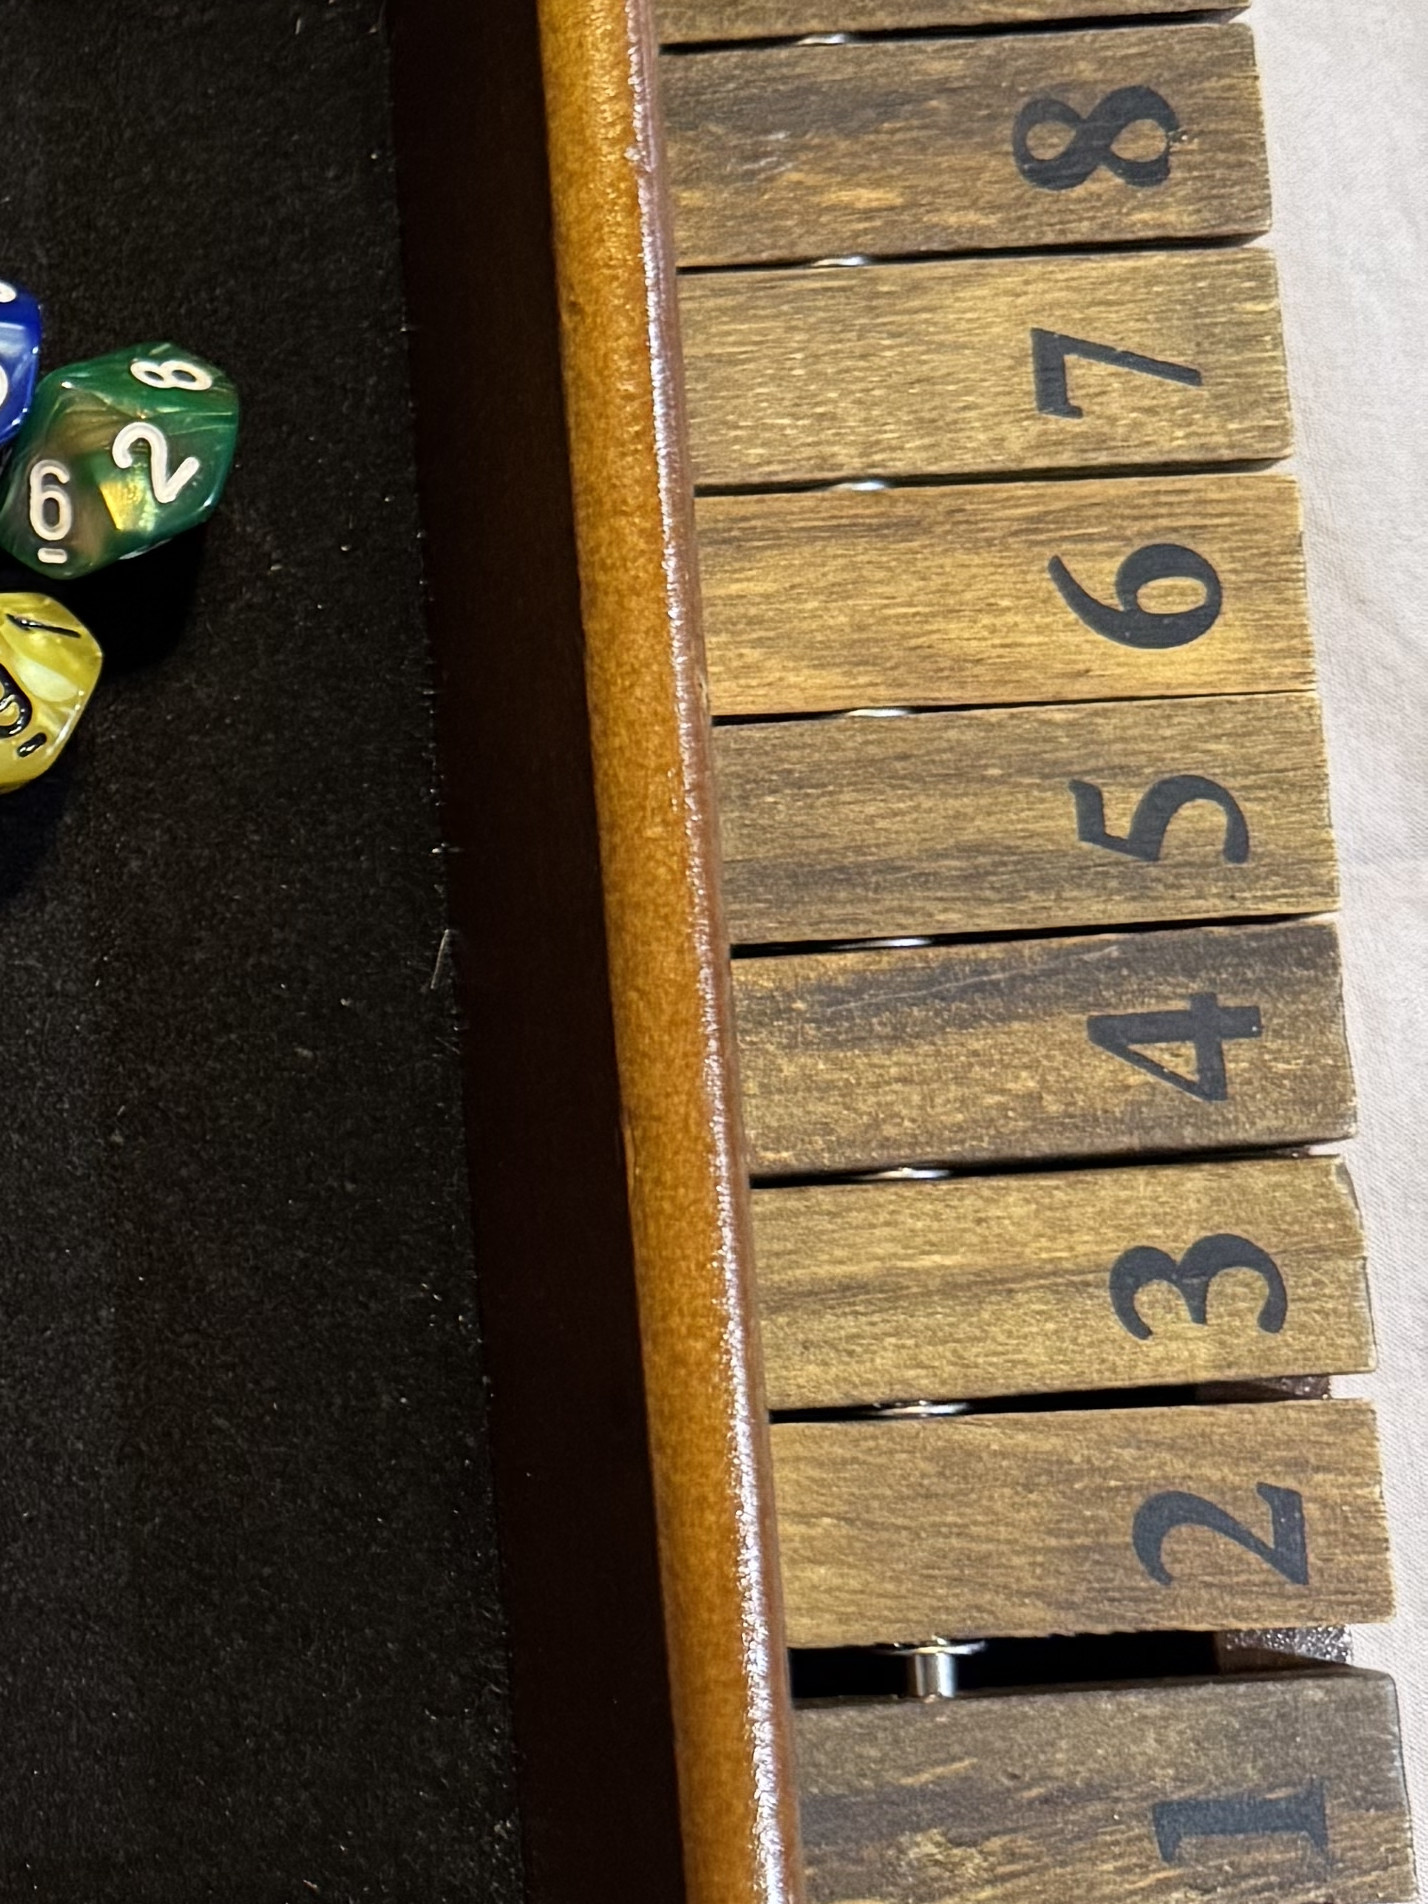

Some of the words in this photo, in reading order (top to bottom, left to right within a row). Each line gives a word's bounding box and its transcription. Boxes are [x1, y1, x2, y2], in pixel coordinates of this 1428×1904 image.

[1012, 85, 1179, 189] 8
[130, 360, 212, 391] 8
[1031, 327, 1201, 419] 7
[112, 421, 200, 504] 2
[1049, 543, 1222, 649] 6
[1069, 774, 1249, 863] 5
[1089, 992, 1260, 1101] 4
[1109, 1233, 1287, 1339] 3
[1133, 1484, 1309, 1586] 2
[1152, 1779, 1327, 1862] 1
